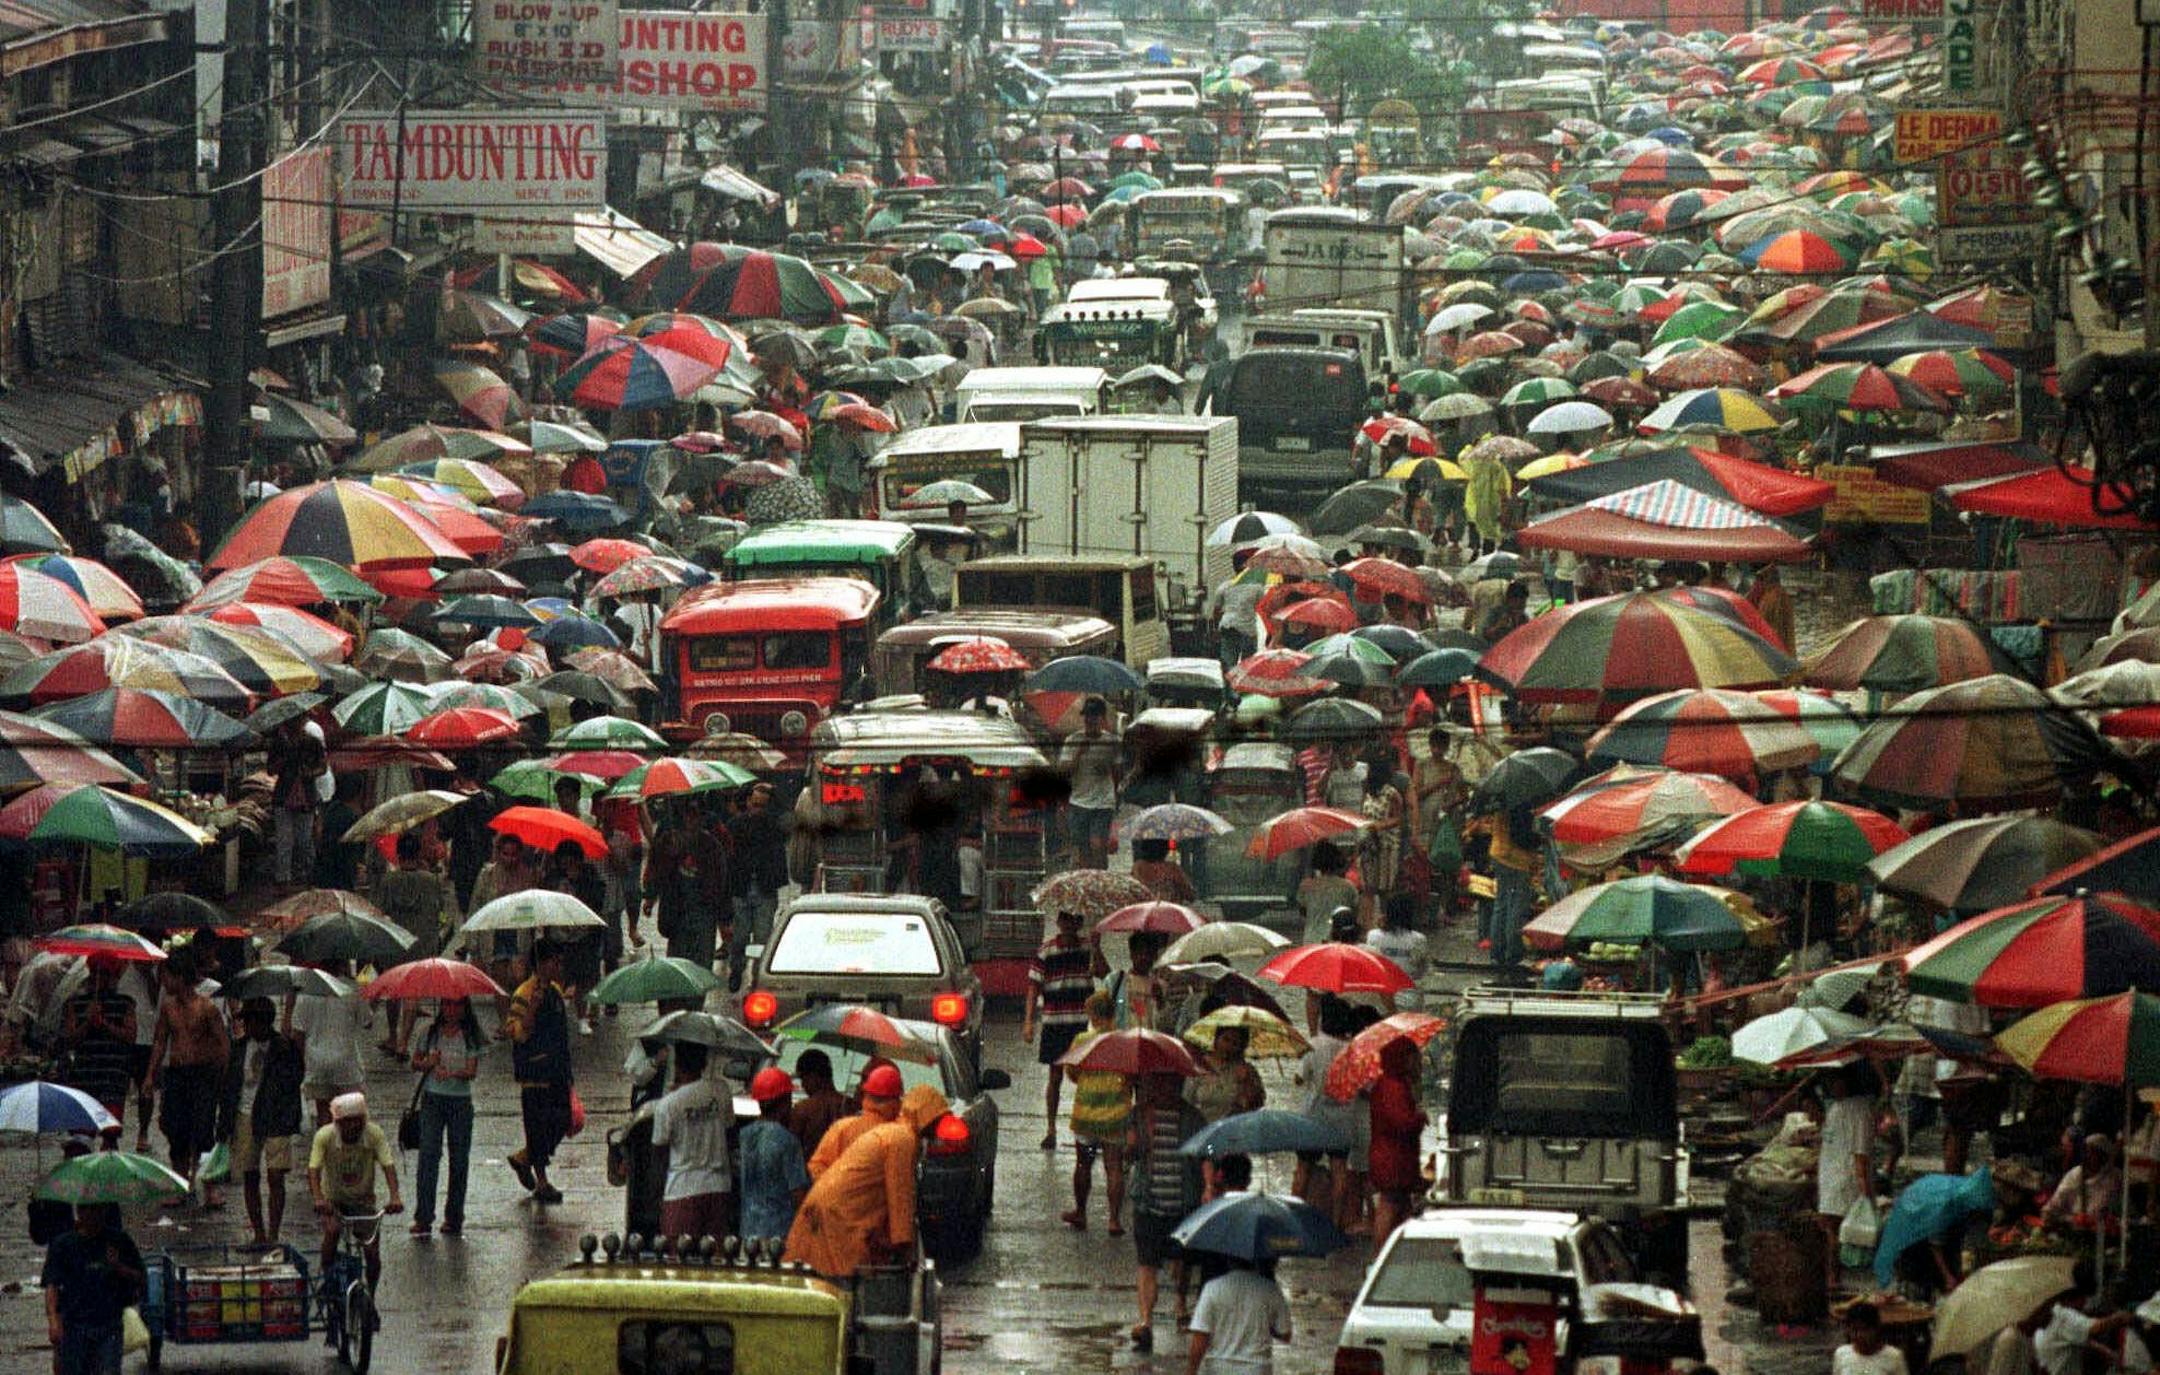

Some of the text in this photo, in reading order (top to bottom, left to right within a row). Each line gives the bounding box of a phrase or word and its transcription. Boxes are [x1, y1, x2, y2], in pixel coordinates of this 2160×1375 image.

[494, 3, 552, 20] BLOW
[571, 5, 599, 22] UP
[617, 18, 746, 53] UNTING
[487, 40, 549, 57] RUSH
[487, 60, 605, 77] PASSPORT
[1898, 115, 1999, 141] LE DERMA
[345, 122, 597, 181] TAMBUNTING
